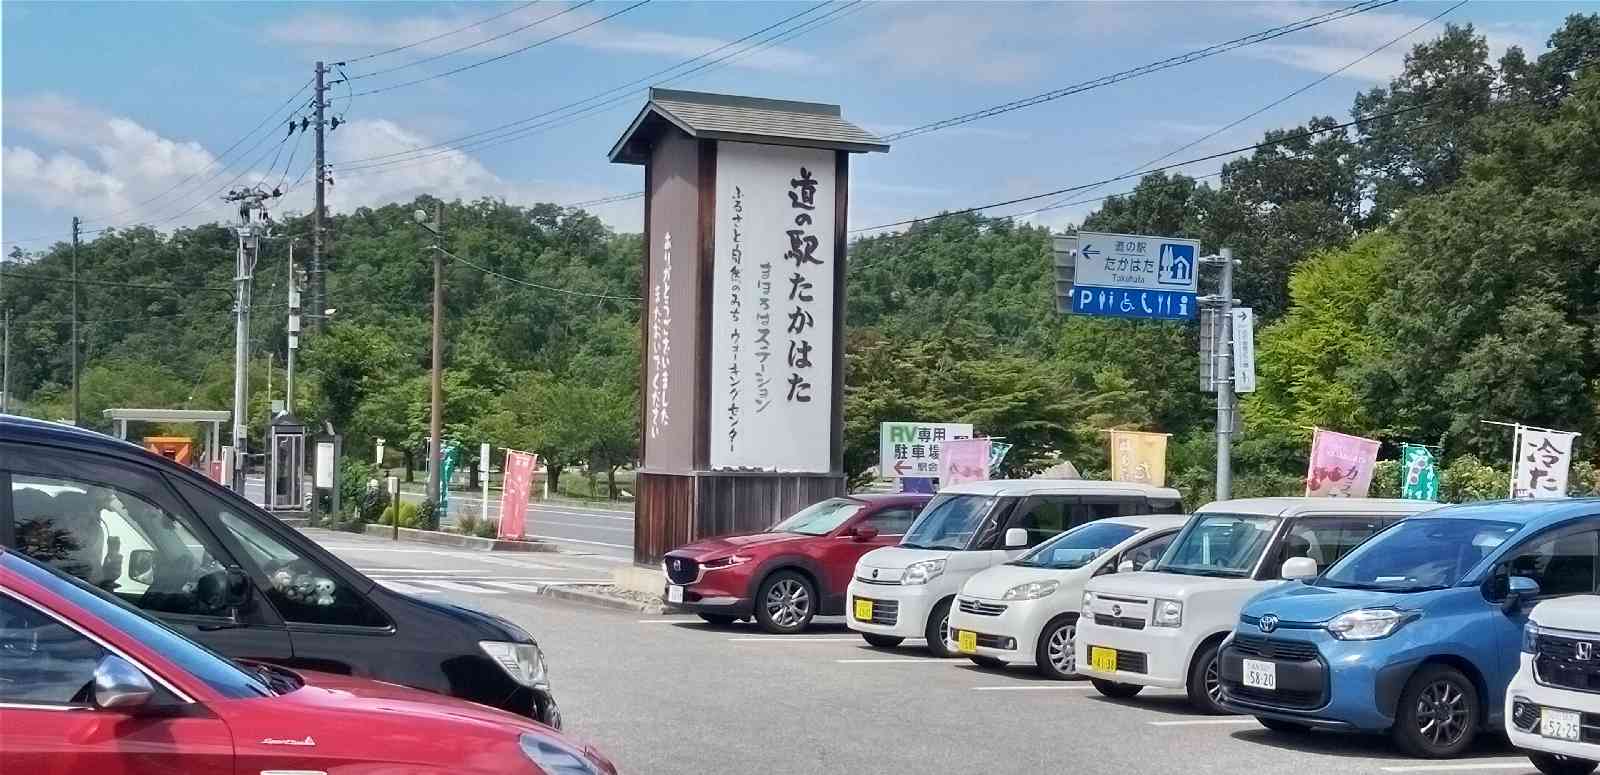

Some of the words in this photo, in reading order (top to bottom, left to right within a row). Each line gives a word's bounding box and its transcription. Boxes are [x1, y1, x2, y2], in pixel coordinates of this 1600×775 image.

[1115, 240, 1148, 253] 道の駅
[1104, 257, 1155, 273] たかはた
[890, 425, 946, 442] RV専用
[1528, 438, 1564, 498] 冷た
